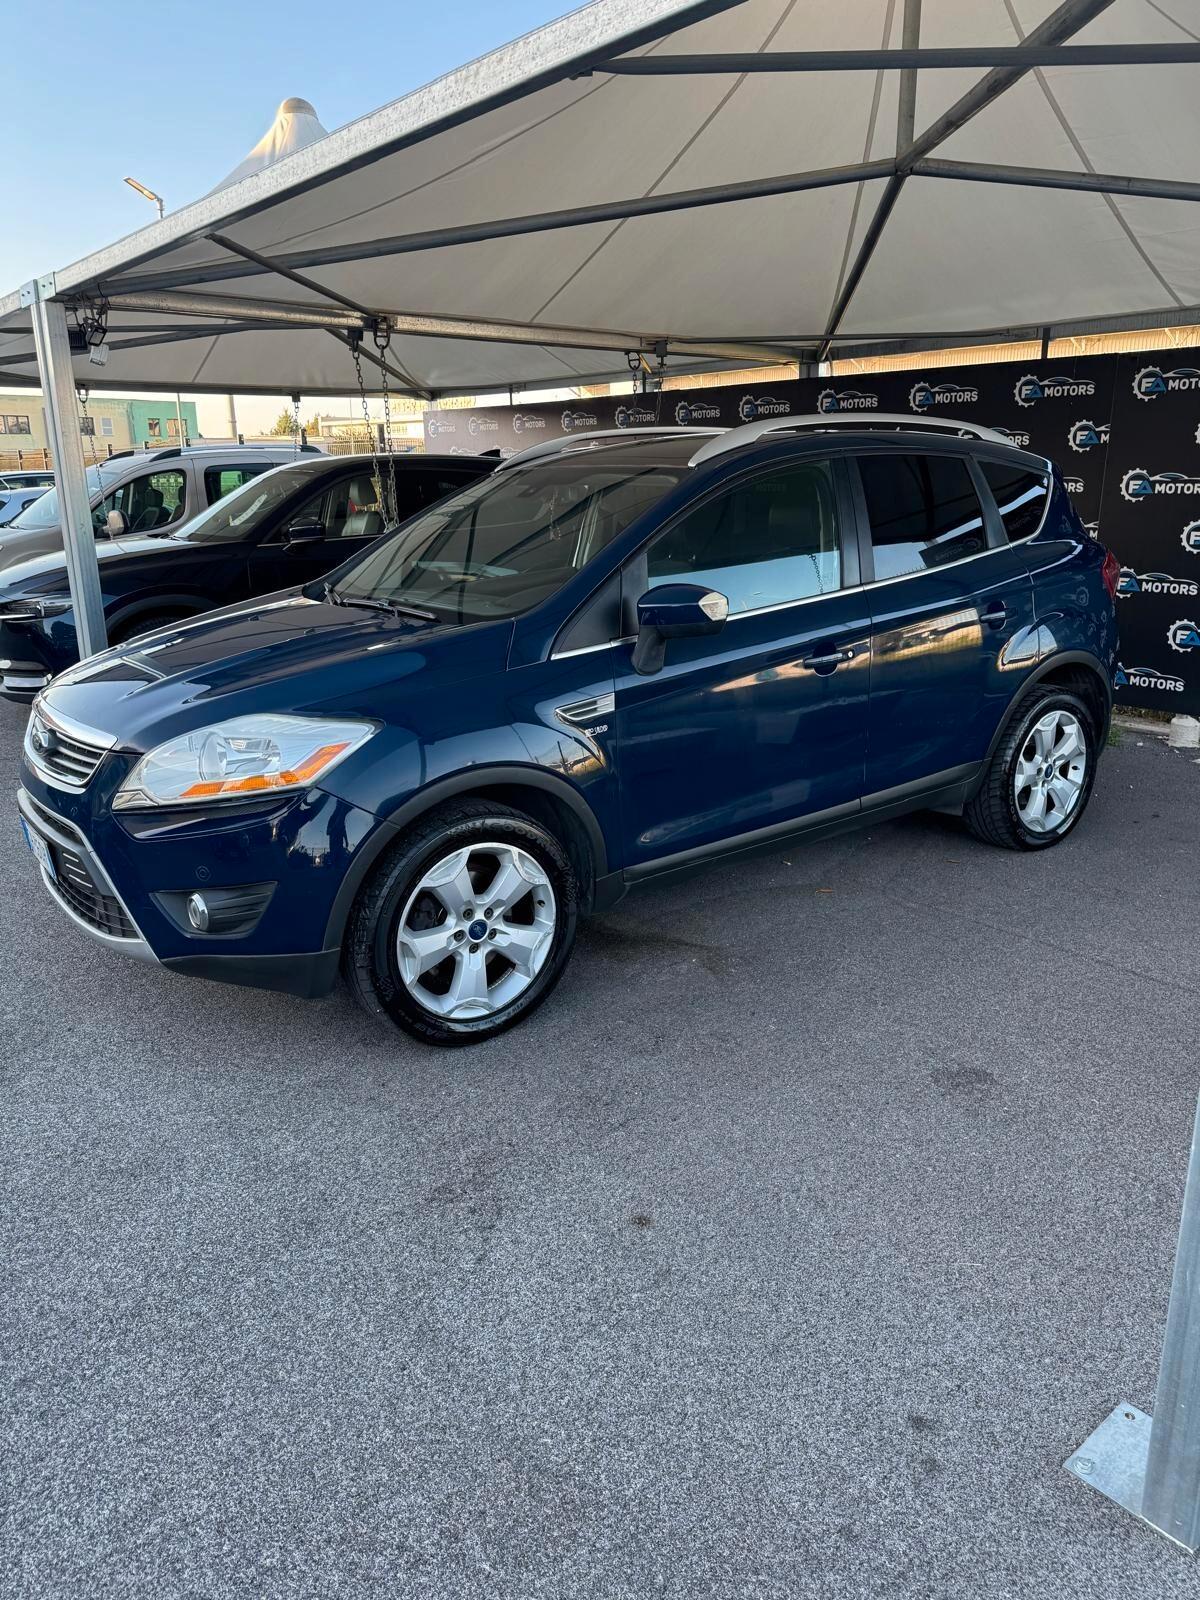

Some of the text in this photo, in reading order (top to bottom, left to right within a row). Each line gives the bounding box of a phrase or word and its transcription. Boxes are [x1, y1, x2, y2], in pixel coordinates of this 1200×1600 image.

[1021, 384, 1096, 399] FA MOTORS
[1140, 377, 1200, 392] FA MOT
[822, 397, 879, 411] FA MOTORS
[915, 391, 979, 405] FA MOTORS
[691, 408, 721, 419] MOTORS
[757, 402, 791, 415] MOTORS
[480, 422, 499, 432] MOTORS
[525, 420, 546, 429] MOTORS
[574, 417, 598, 427] MOTORS
[1075, 430, 1100, 446] FA
[1128, 480, 1153, 494] FA
[1141, 581, 1198, 596] MOTORS
[1129, 675, 1185, 692] MOTORS
